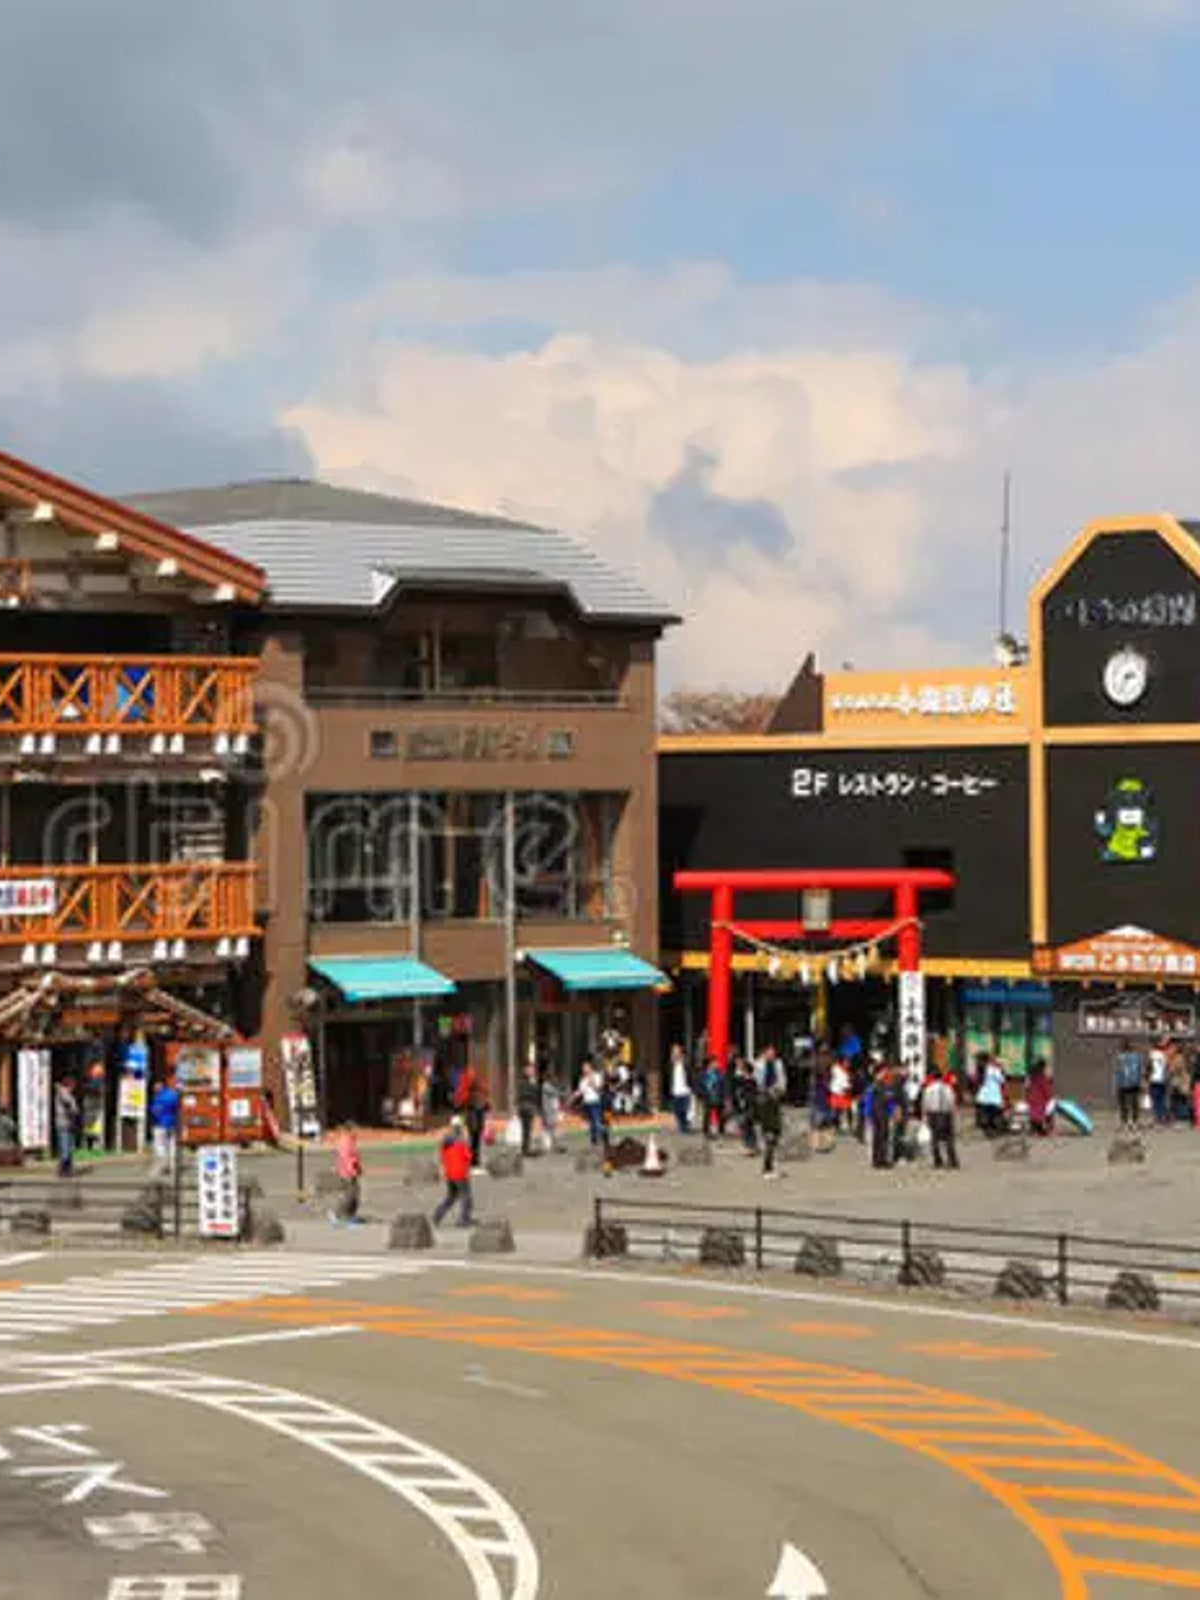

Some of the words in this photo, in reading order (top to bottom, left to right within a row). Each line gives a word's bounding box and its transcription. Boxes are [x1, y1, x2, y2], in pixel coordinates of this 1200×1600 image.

[793, 768, 829, 797] 2F
[838, 772, 999, 796] レストラン・コーヒー
